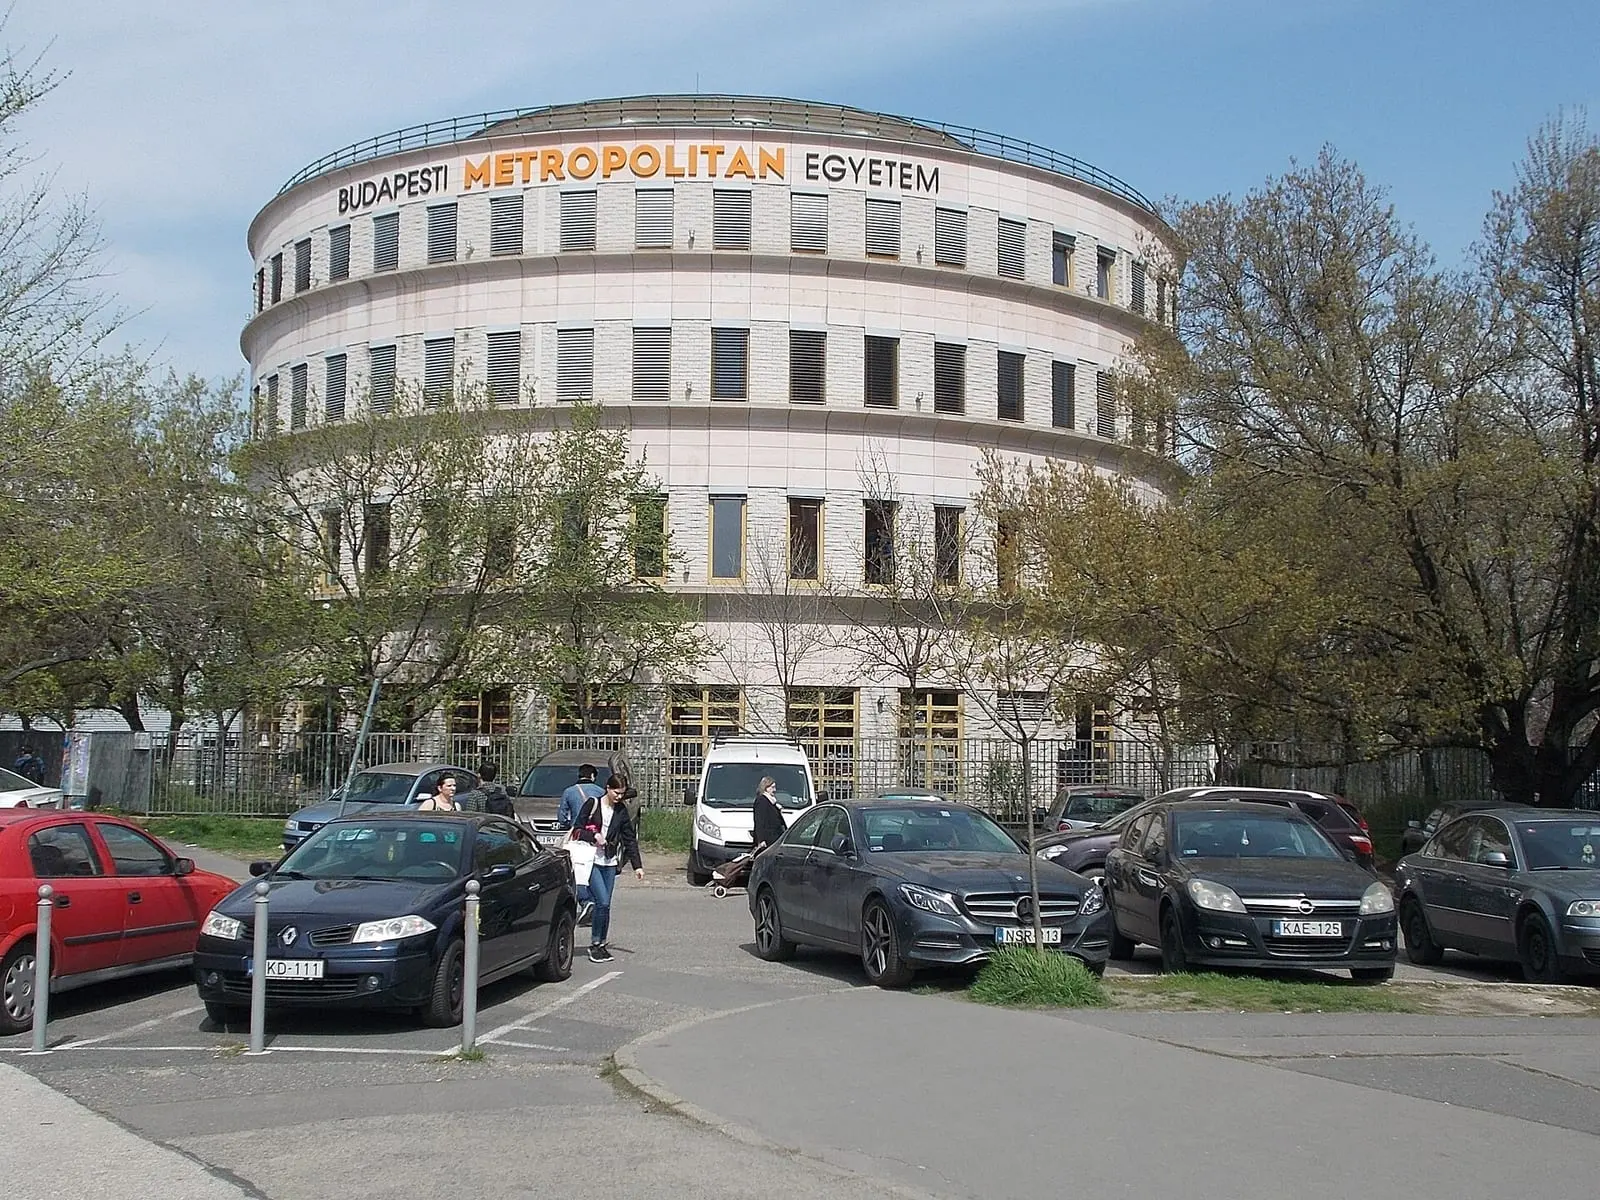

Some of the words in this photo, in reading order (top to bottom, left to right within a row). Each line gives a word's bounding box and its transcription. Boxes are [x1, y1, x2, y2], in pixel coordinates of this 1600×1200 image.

[338, 164, 448, 215] BUDAPESTI
[463, 143, 785, 191] METROPOLITAN
[805, 152, 940, 194] EGYETEM
[1282, 922, 1340, 935] KAE-125
[265, 961, 319, 977] KD-111
